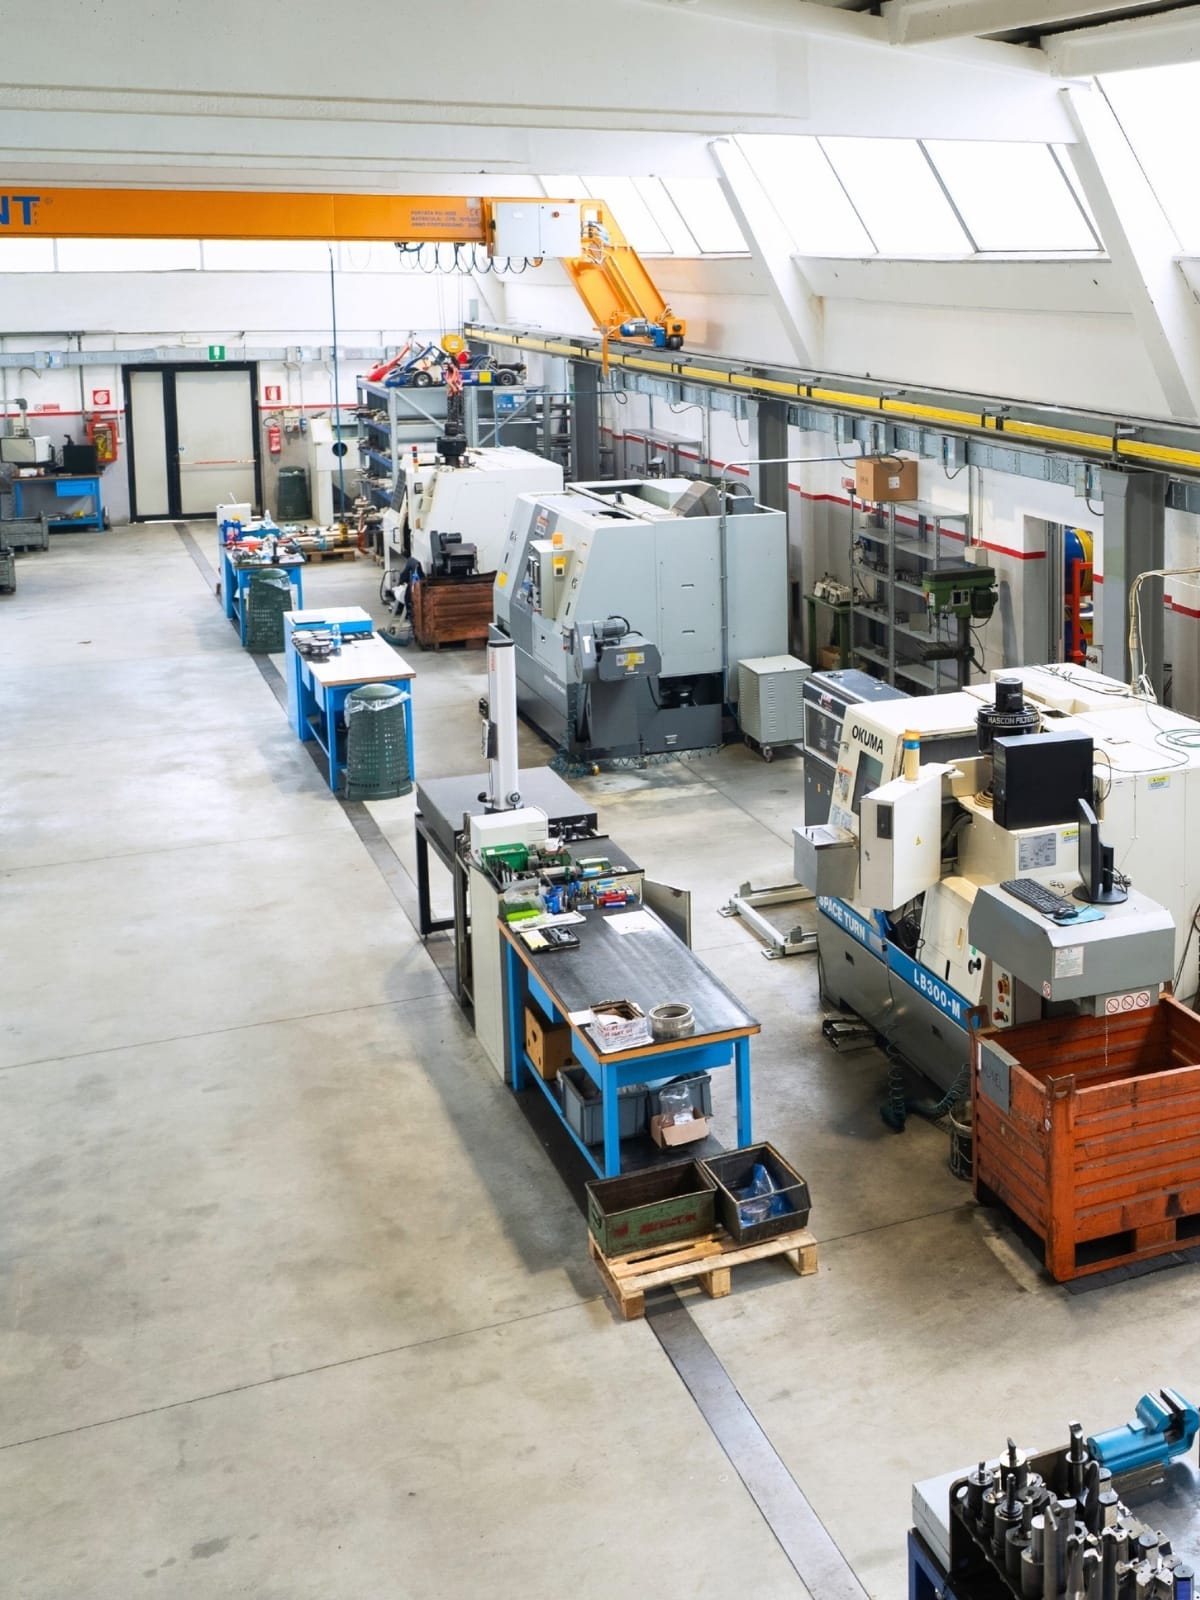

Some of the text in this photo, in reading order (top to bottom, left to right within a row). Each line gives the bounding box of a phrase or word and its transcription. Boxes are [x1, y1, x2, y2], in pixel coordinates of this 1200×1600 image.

[852, 725, 884, 755] OKUMA
[819, 896, 865, 940] SPACE TURN
[914, 968, 960, 1019] LB300-M
